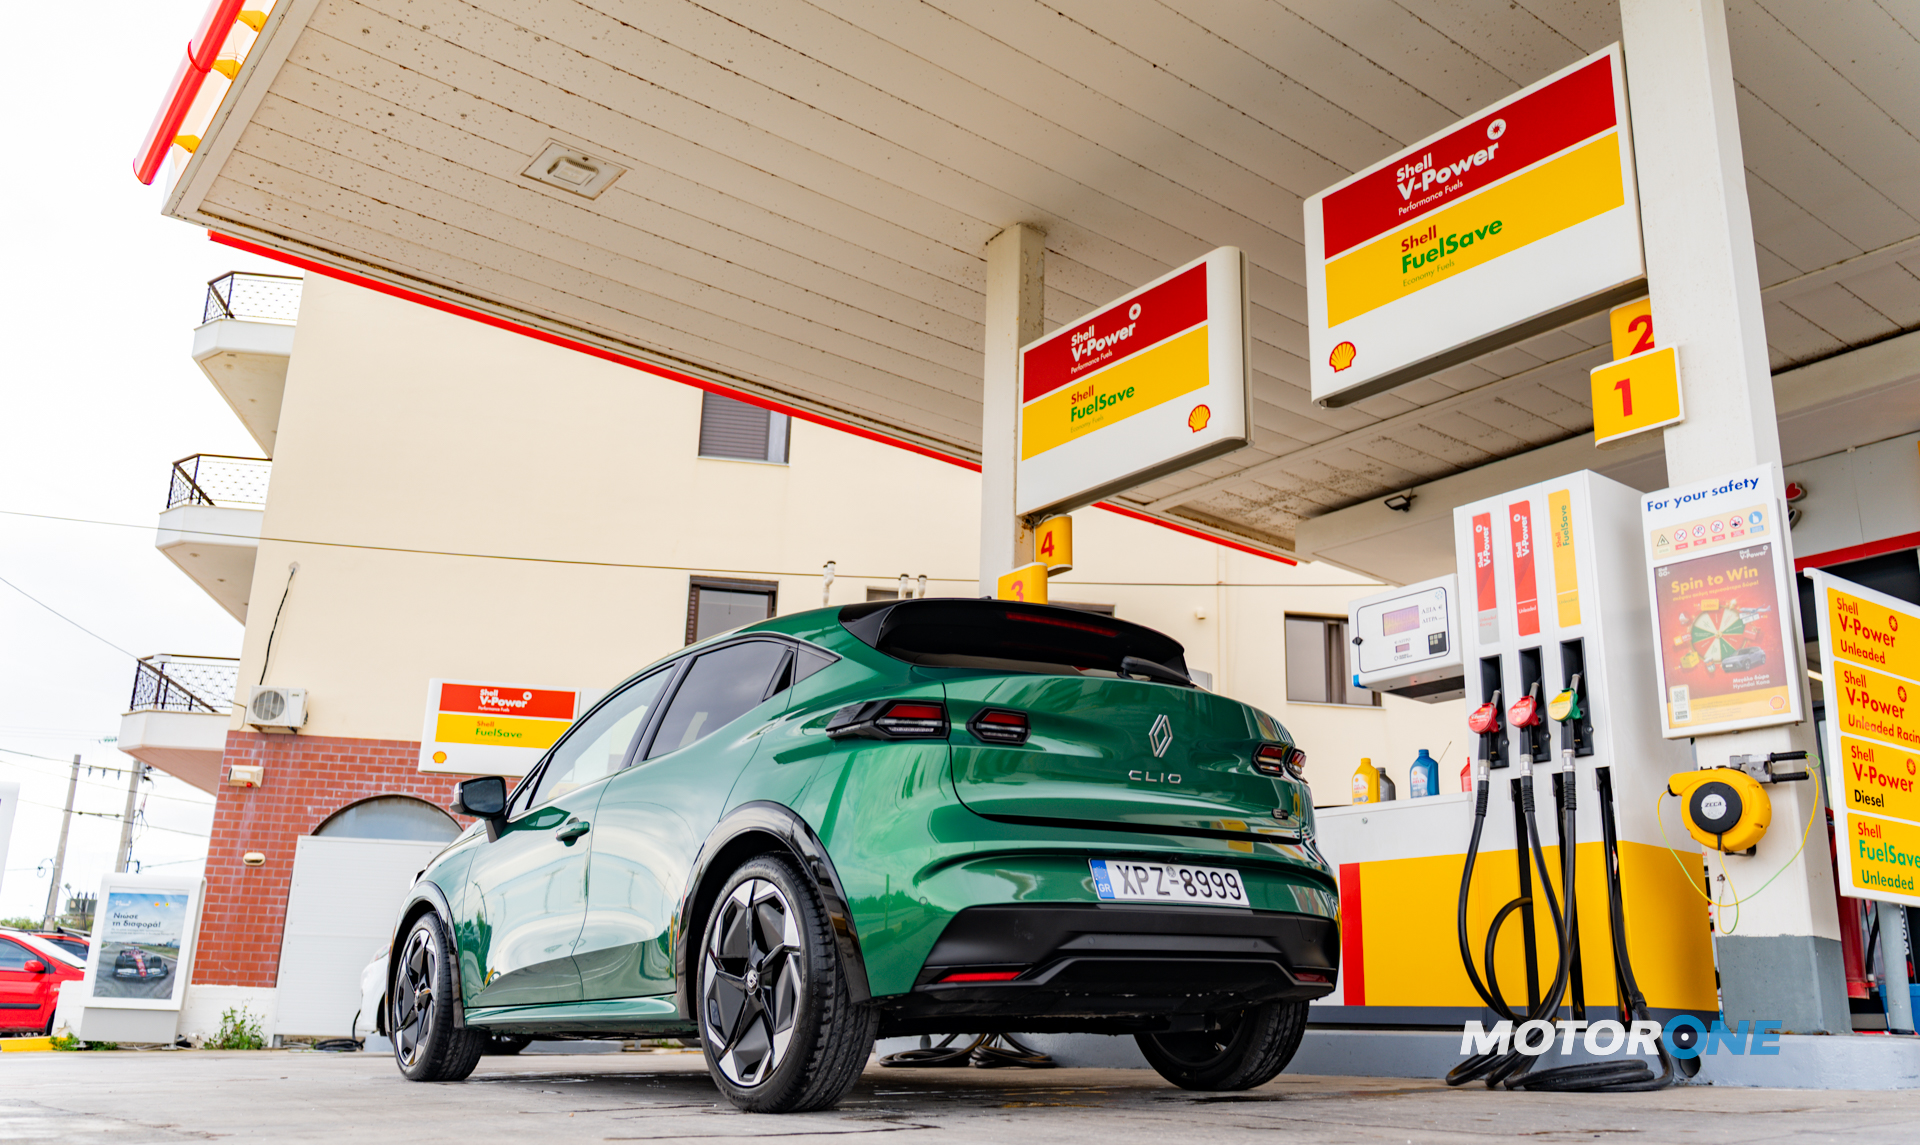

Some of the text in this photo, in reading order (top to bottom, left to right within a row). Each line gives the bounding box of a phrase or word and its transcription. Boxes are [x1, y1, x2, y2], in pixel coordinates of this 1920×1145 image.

[1396, 152, 1432, 182] Shell
[1397, 142, 1499, 200] V-Power
[1398, 179, 1463, 216] Performance Fuels
[1401, 224, 1437, 253] Shell
[1402, 220, 1503, 274] FuelSave
[1403, 259, 1455, 287] Economy Fuels
[1071, 324, 1095, 346] Shell
[1071, 322, 1136, 362] V-Power
[1627, 314, 1655, 356] 2
[1070, 349, 1113, 374] Performance Fuels
[1071, 384, 1094, 405] Shell
[1071, 386, 1135, 422] FuelSave
[1613, 378, 1633, 417] 1
[1646, 477, 1760, 512] For your safety
[1522, 515, 1530, 557] V-Power
[1561, 505, 1570, 547] FuelSave
[1040, 530, 1055, 557] 4
[1483, 526, 1491, 567] V-Power
[1011, 579, 1024, 602] 3
[1671, 566, 1758, 595] Spin to Win
[1518, 605, 1537, 614] Unleaded
[1836, 597, 1859, 616] Shell
[1838, 613, 1896, 648] V-Power
[1840, 638, 1886, 664] Unleaded
[1843, 670, 1867, 688] Shell
[479, 695, 528, 708] V-Power
[480, 688, 499, 697] Shell
[1845, 686, 1905, 719] V-Power
[475, 728, 523, 739] FuelSave
[476, 720, 495, 728] Shell
[1848, 713, 1895, 737] Unleaded
[1851, 745, 1875, 763] Shell
[1128, 769, 1182, 784] CLIO
[1852, 762, 1914, 793] V-Power
[1854, 789, 1885, 808] Diesel
[1857, 822, 1882, 839] Shell
[1859, 839, 1920, 869] FuelSave
[1098, 883, 1112, 894] GR
[1115, 863, 1242, 900] XPZ-8999
[1862, 869, 1914, 890] Unleaded
[113, 912, 138, 920] Νιώσε
[123, 920, 161, 929] διαφορά!
